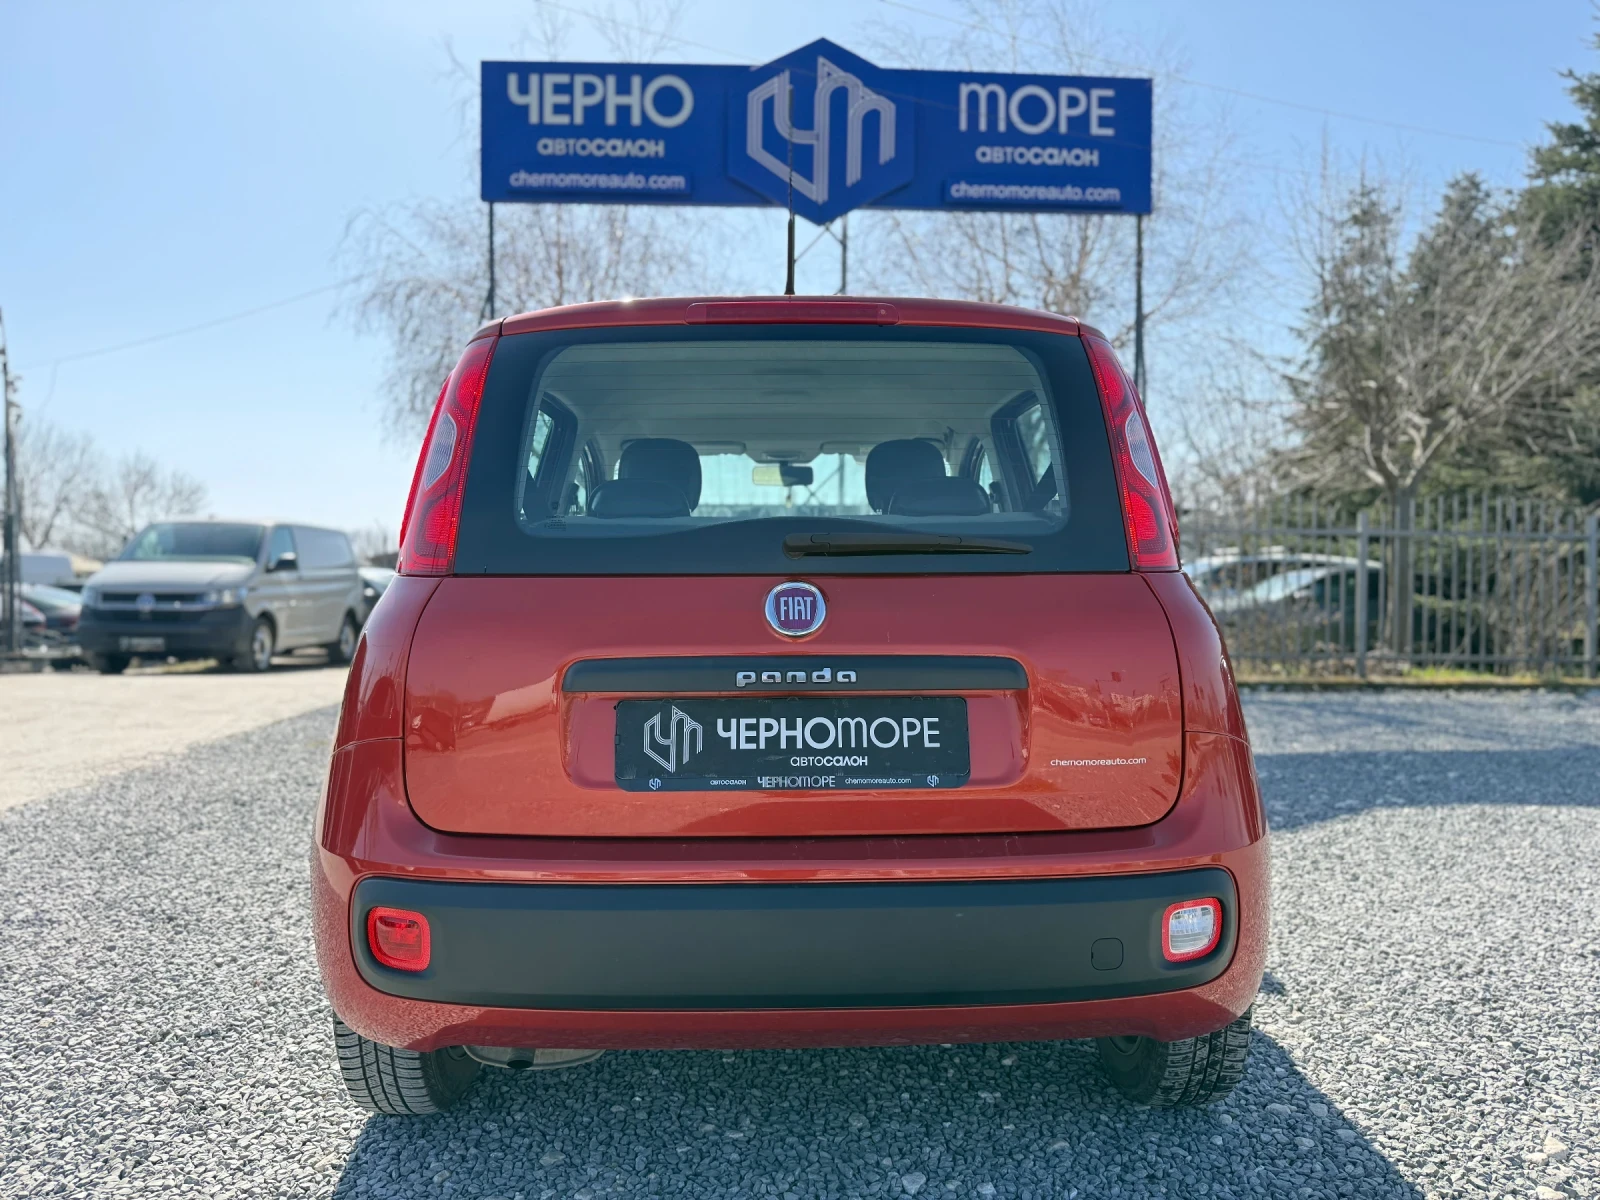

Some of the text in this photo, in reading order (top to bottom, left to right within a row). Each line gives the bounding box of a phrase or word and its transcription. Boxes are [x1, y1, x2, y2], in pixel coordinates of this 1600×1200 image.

[507, 72, 694, 128] ЧЕРНО
[959, 82, 1115, 136] МОРЕ
[537, 137, 665, 158] автосалон
[975, 145, 1099, 167] автосалон
[509, 169, 686, 190] chernomoreauto.com
[951, 181, 1121, 202] chernomoreauto.com
[779, 596, 814, 621] FIAT
[735, 667, 857, 687] panda
[716, 716, 941, 750] ЧЕРНОМОРЕ
[790, 755, 868, 767] автосалон
[1050, 757, 1147, 767] chernomoreauto.com
[844, 777, 912, 785] chernomoreauto.com
